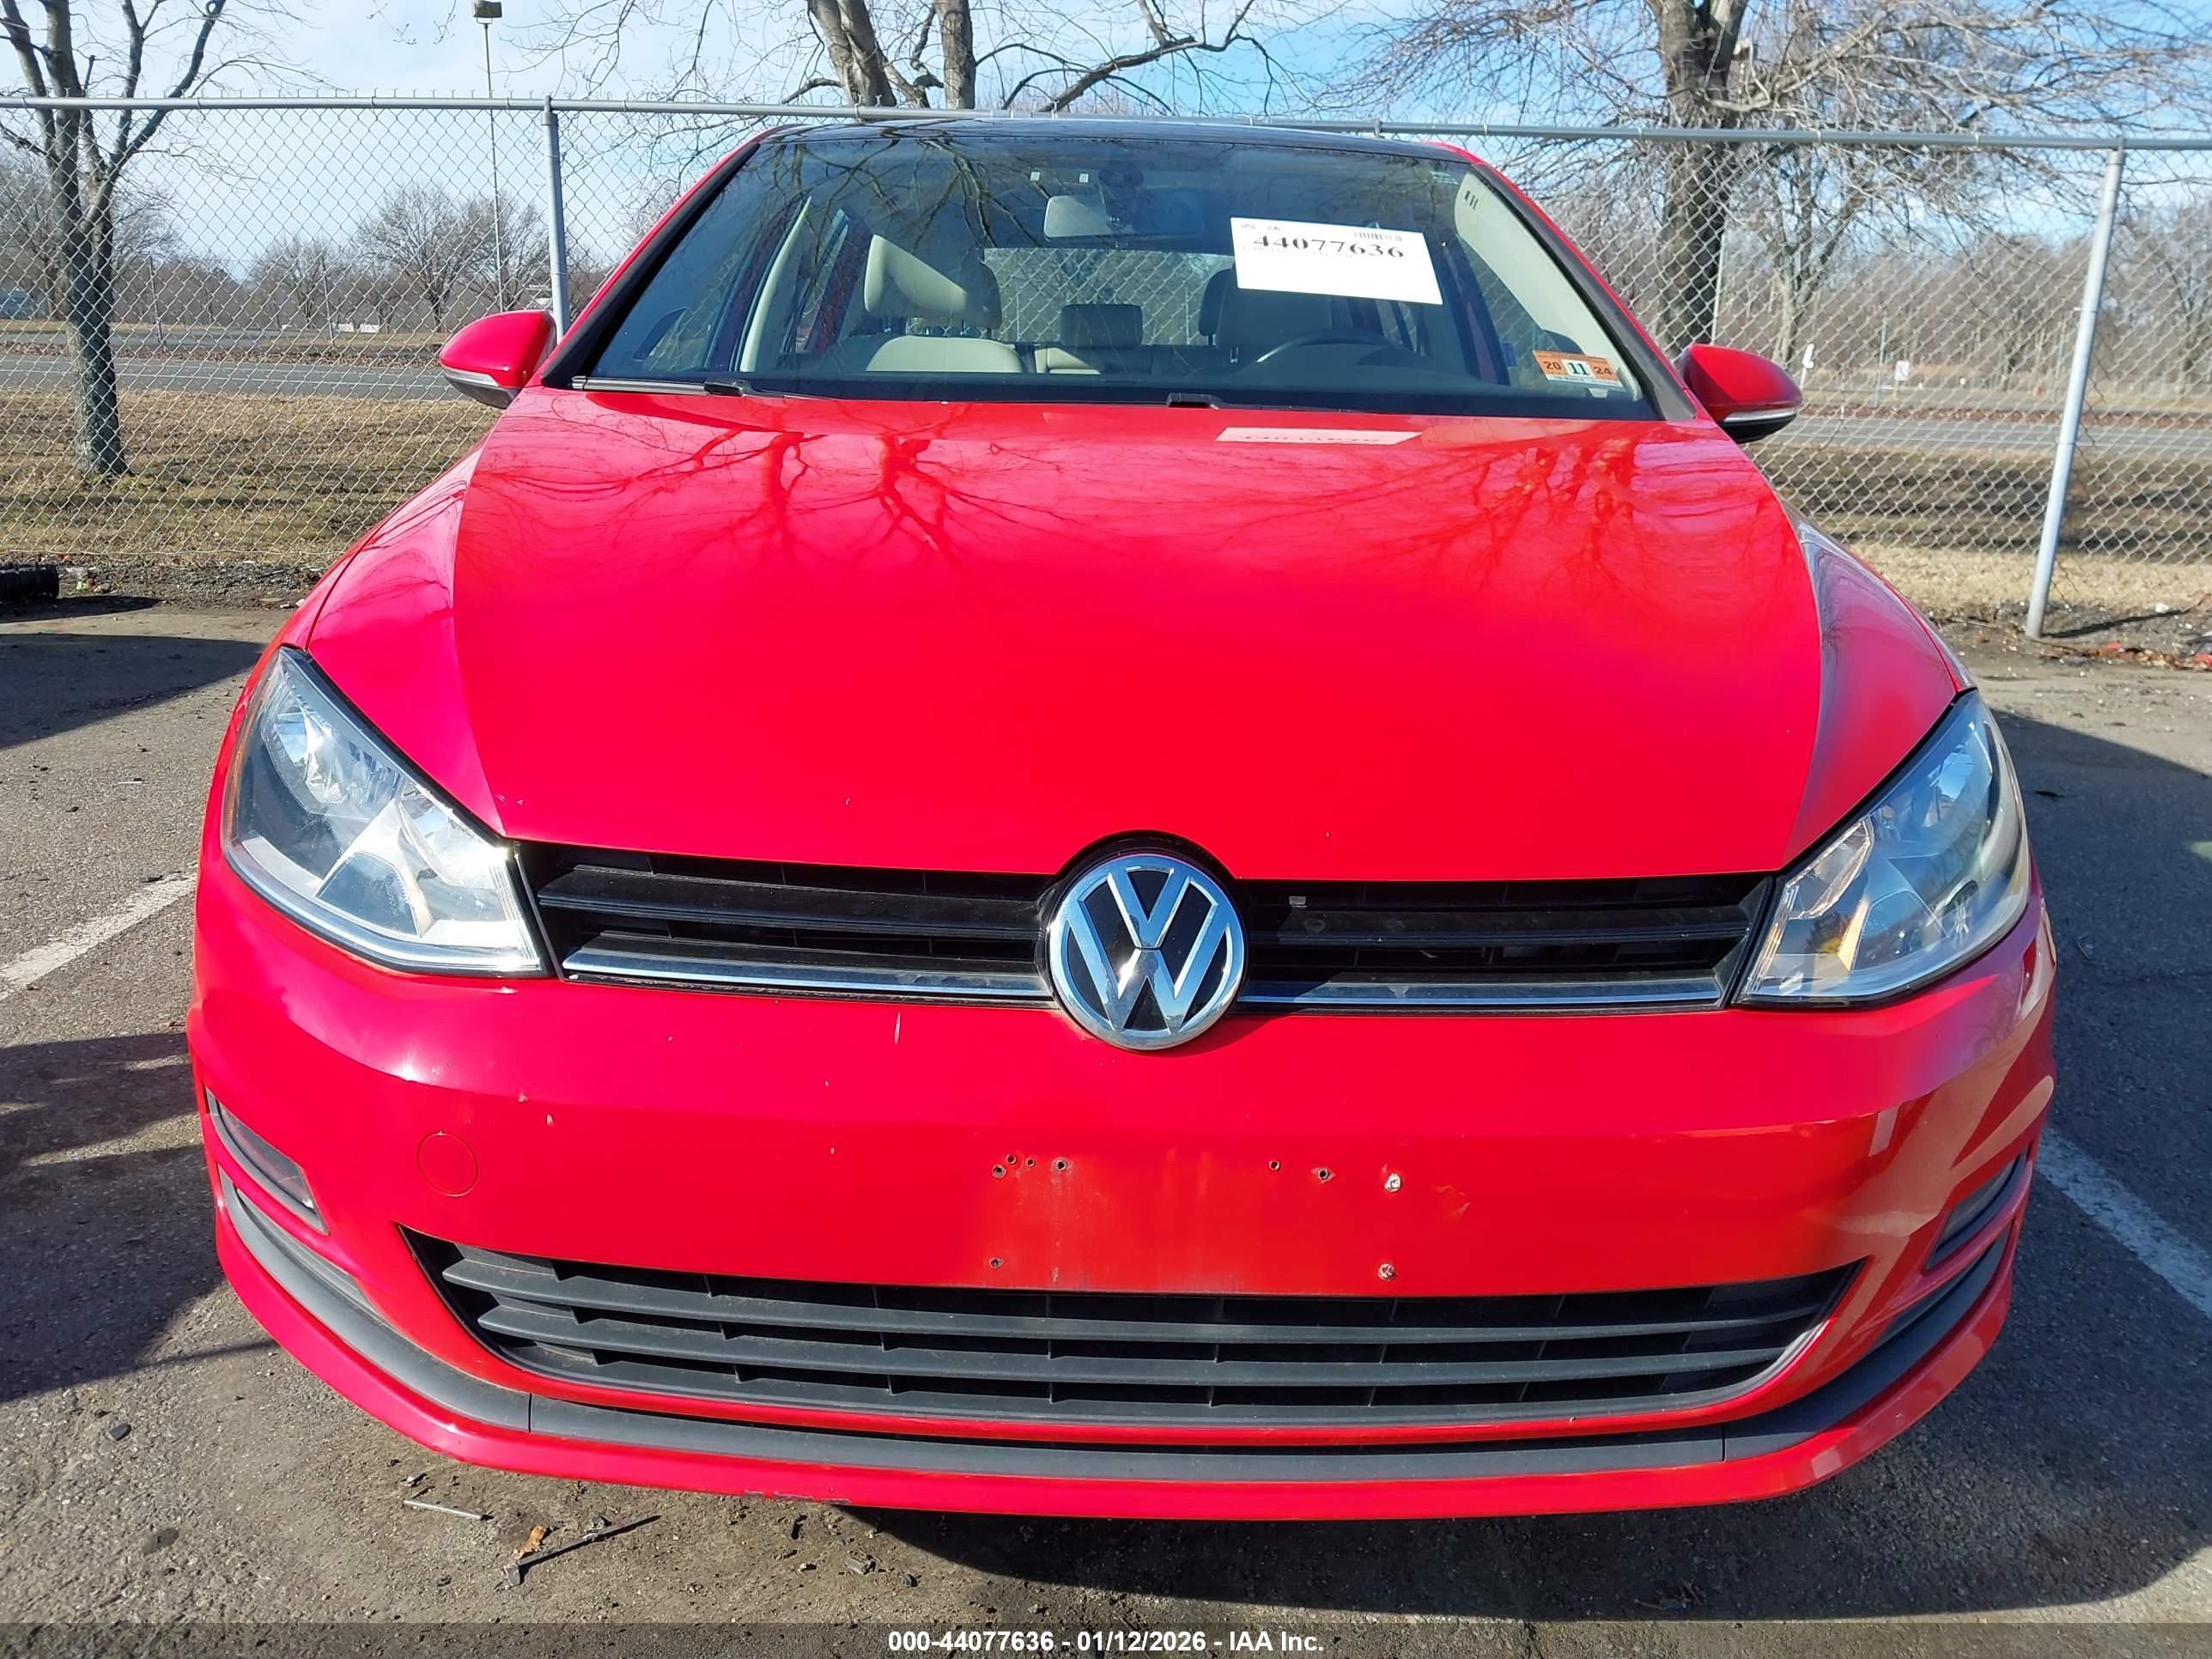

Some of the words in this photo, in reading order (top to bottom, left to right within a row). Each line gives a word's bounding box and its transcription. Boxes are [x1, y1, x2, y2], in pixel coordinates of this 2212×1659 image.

[1254, 235, 1404, 258] 44077636
[1544, 361, 1562, 370] 20
[1568, 362, 1589, 375] 11
